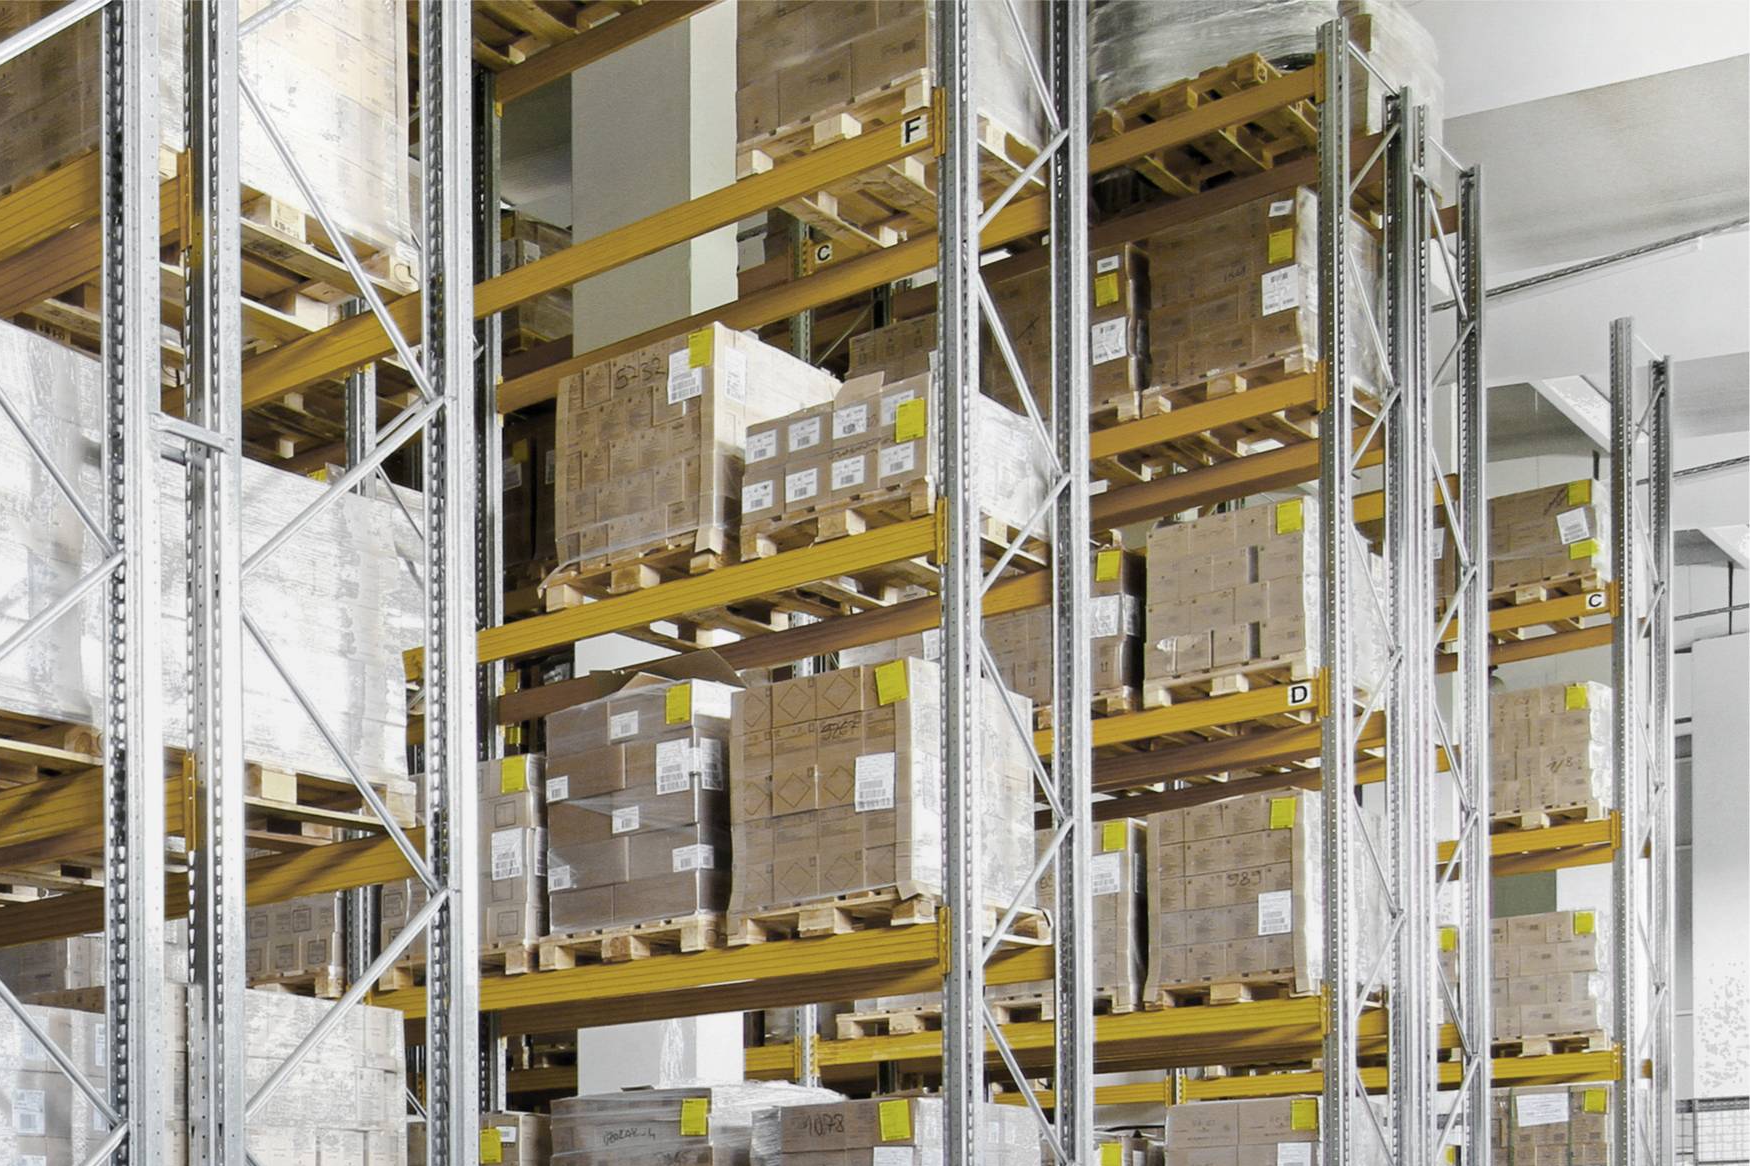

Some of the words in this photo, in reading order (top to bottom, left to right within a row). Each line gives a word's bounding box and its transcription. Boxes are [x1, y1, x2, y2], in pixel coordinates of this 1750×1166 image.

[905, 116, 921, 144] F
[817, 244, 830, 261] C
[1588, 593, 1602, 607] C
[1291, 685, 1308, 703] D
